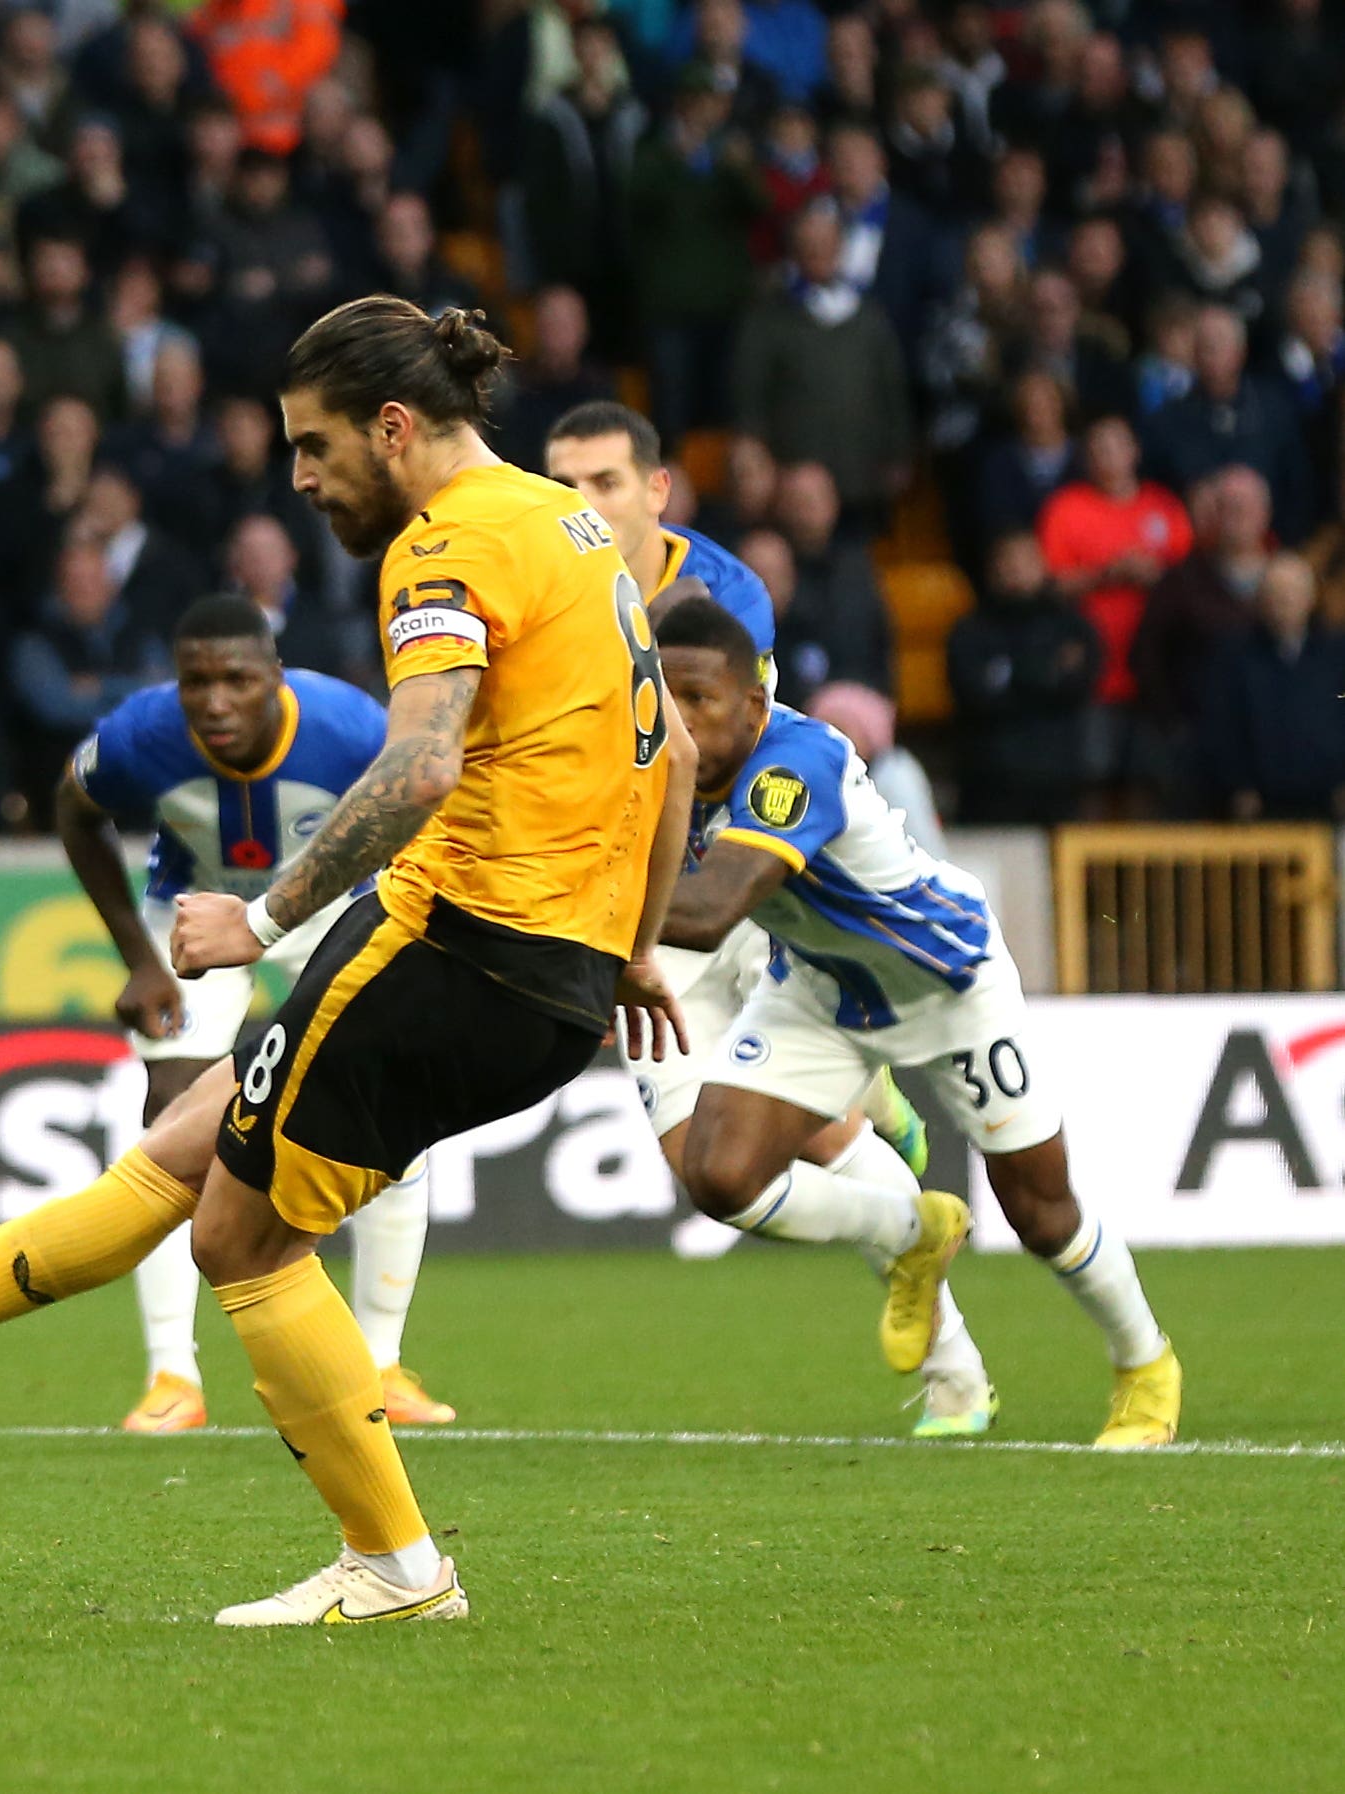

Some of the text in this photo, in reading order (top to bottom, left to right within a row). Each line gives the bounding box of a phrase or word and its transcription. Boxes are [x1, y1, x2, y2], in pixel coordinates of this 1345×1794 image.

[558, 509, 614, 555] NE
[390, 611, 446, 644] ptain
[613, 571, 669, 769] 8
[243, 1022, 287, 1105] 8
[952, 1036, 1031, 1110] 30
[1175, 1030, 1345, 1191] A
